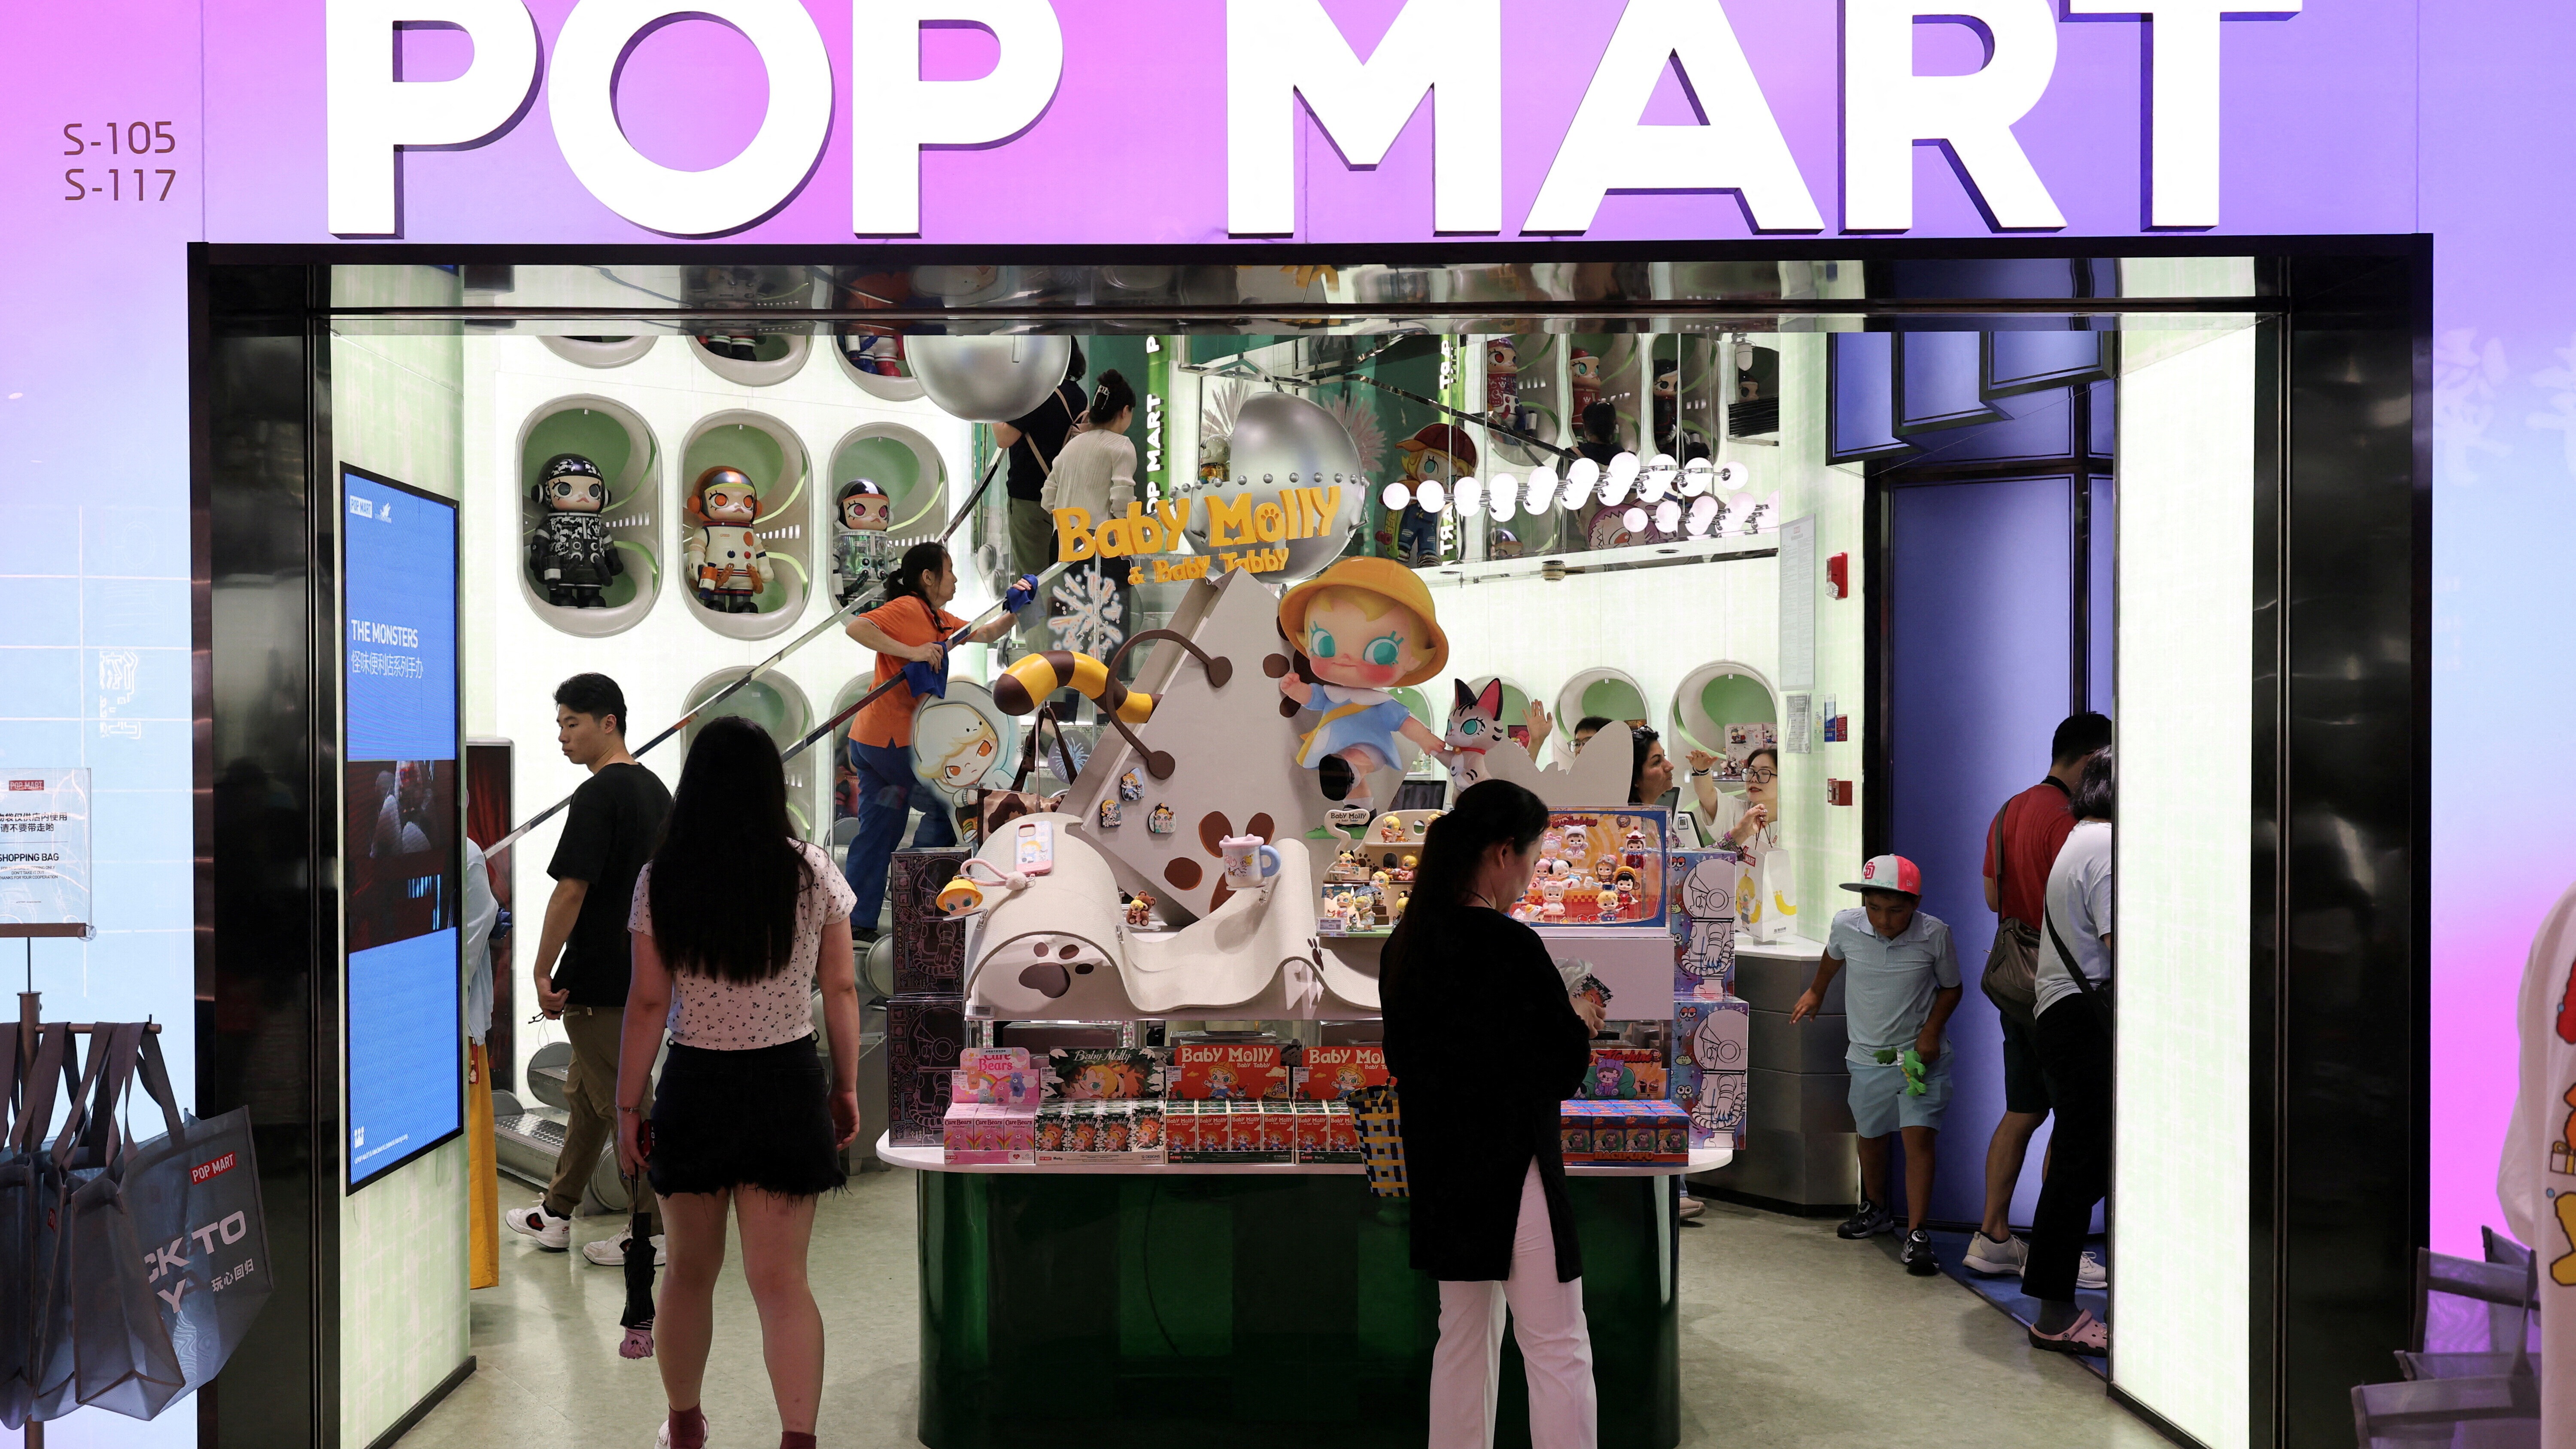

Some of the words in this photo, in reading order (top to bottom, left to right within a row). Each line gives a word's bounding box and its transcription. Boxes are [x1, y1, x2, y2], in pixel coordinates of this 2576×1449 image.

[328, 0, 1064, 239] POP
[1227, 0, 2302, 235] MART
[64, 121, 176, 155] S-105
[65, 168, 176, 201] S-117
[1146, 394, 1161, 472] MART
[1128, 566, 1146, 585] &
[351, 619, 371, 642] THE
[372, 623, 419, 648] MONSTERS
[351, 649, 424, 679] 怪味便利店系列手办
[1, 823, 54, 832] 请不要带走哟
[42, 853, 59, 861] BAG
[978, 1059, 1013, 1071] Bears
[1073, 1050, 1102, 1062] Baby
[1103, 1049, 1131, 1063] Molly
[192, 1165, 211, 1182] POP
[212, 1154, 234, 1174] MART
[191, 1210, 246, 1255] TO
[211, 1258, 255, 1292] 玩心回归
